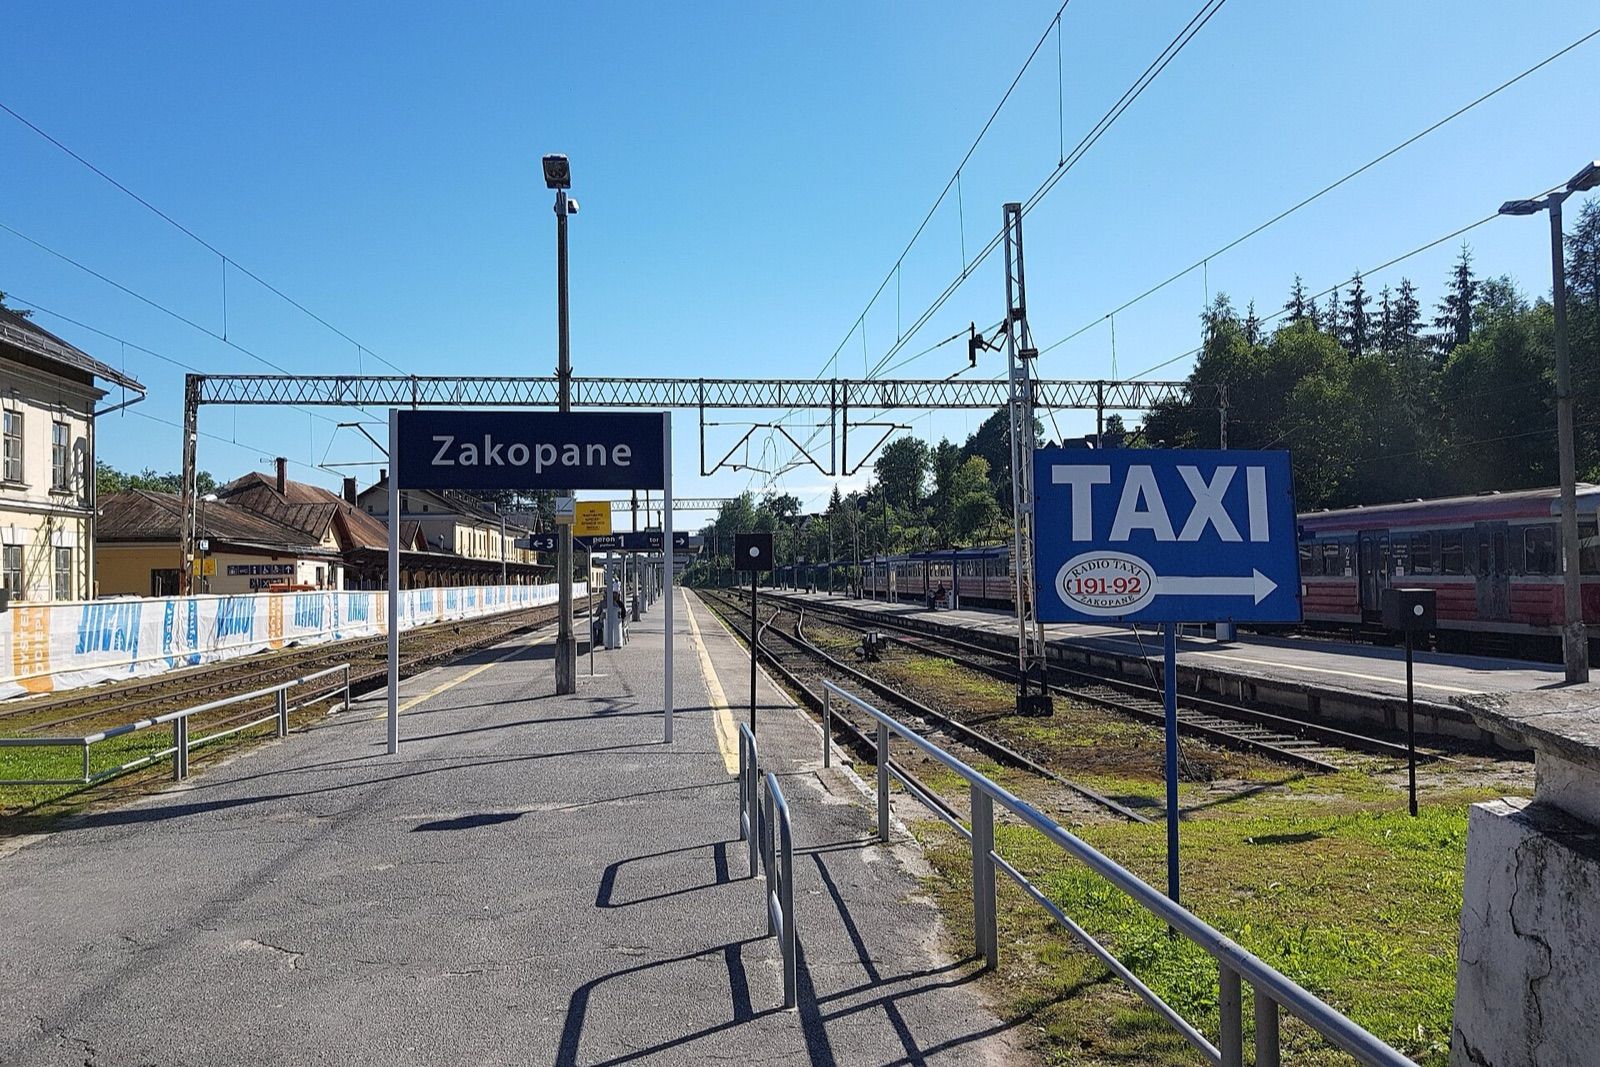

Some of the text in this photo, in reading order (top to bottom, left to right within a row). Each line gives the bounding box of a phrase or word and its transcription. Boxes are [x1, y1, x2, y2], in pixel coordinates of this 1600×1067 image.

[431, 434, 632, 474] Zakopane
[1051, 464, 1270, 542] TAXI
[546, 538, 554, 549] 3
[592, 536, 616, 544] peron
[618, 535, 625, 547] 1
[1345, 547, 1350, 560] 2
[1072, 560, 1142, 578] RADIO TAXI
[1074, 577, 1142, 595] 191-92
[1080, 594, 1136, 606] ZAKOPANE
